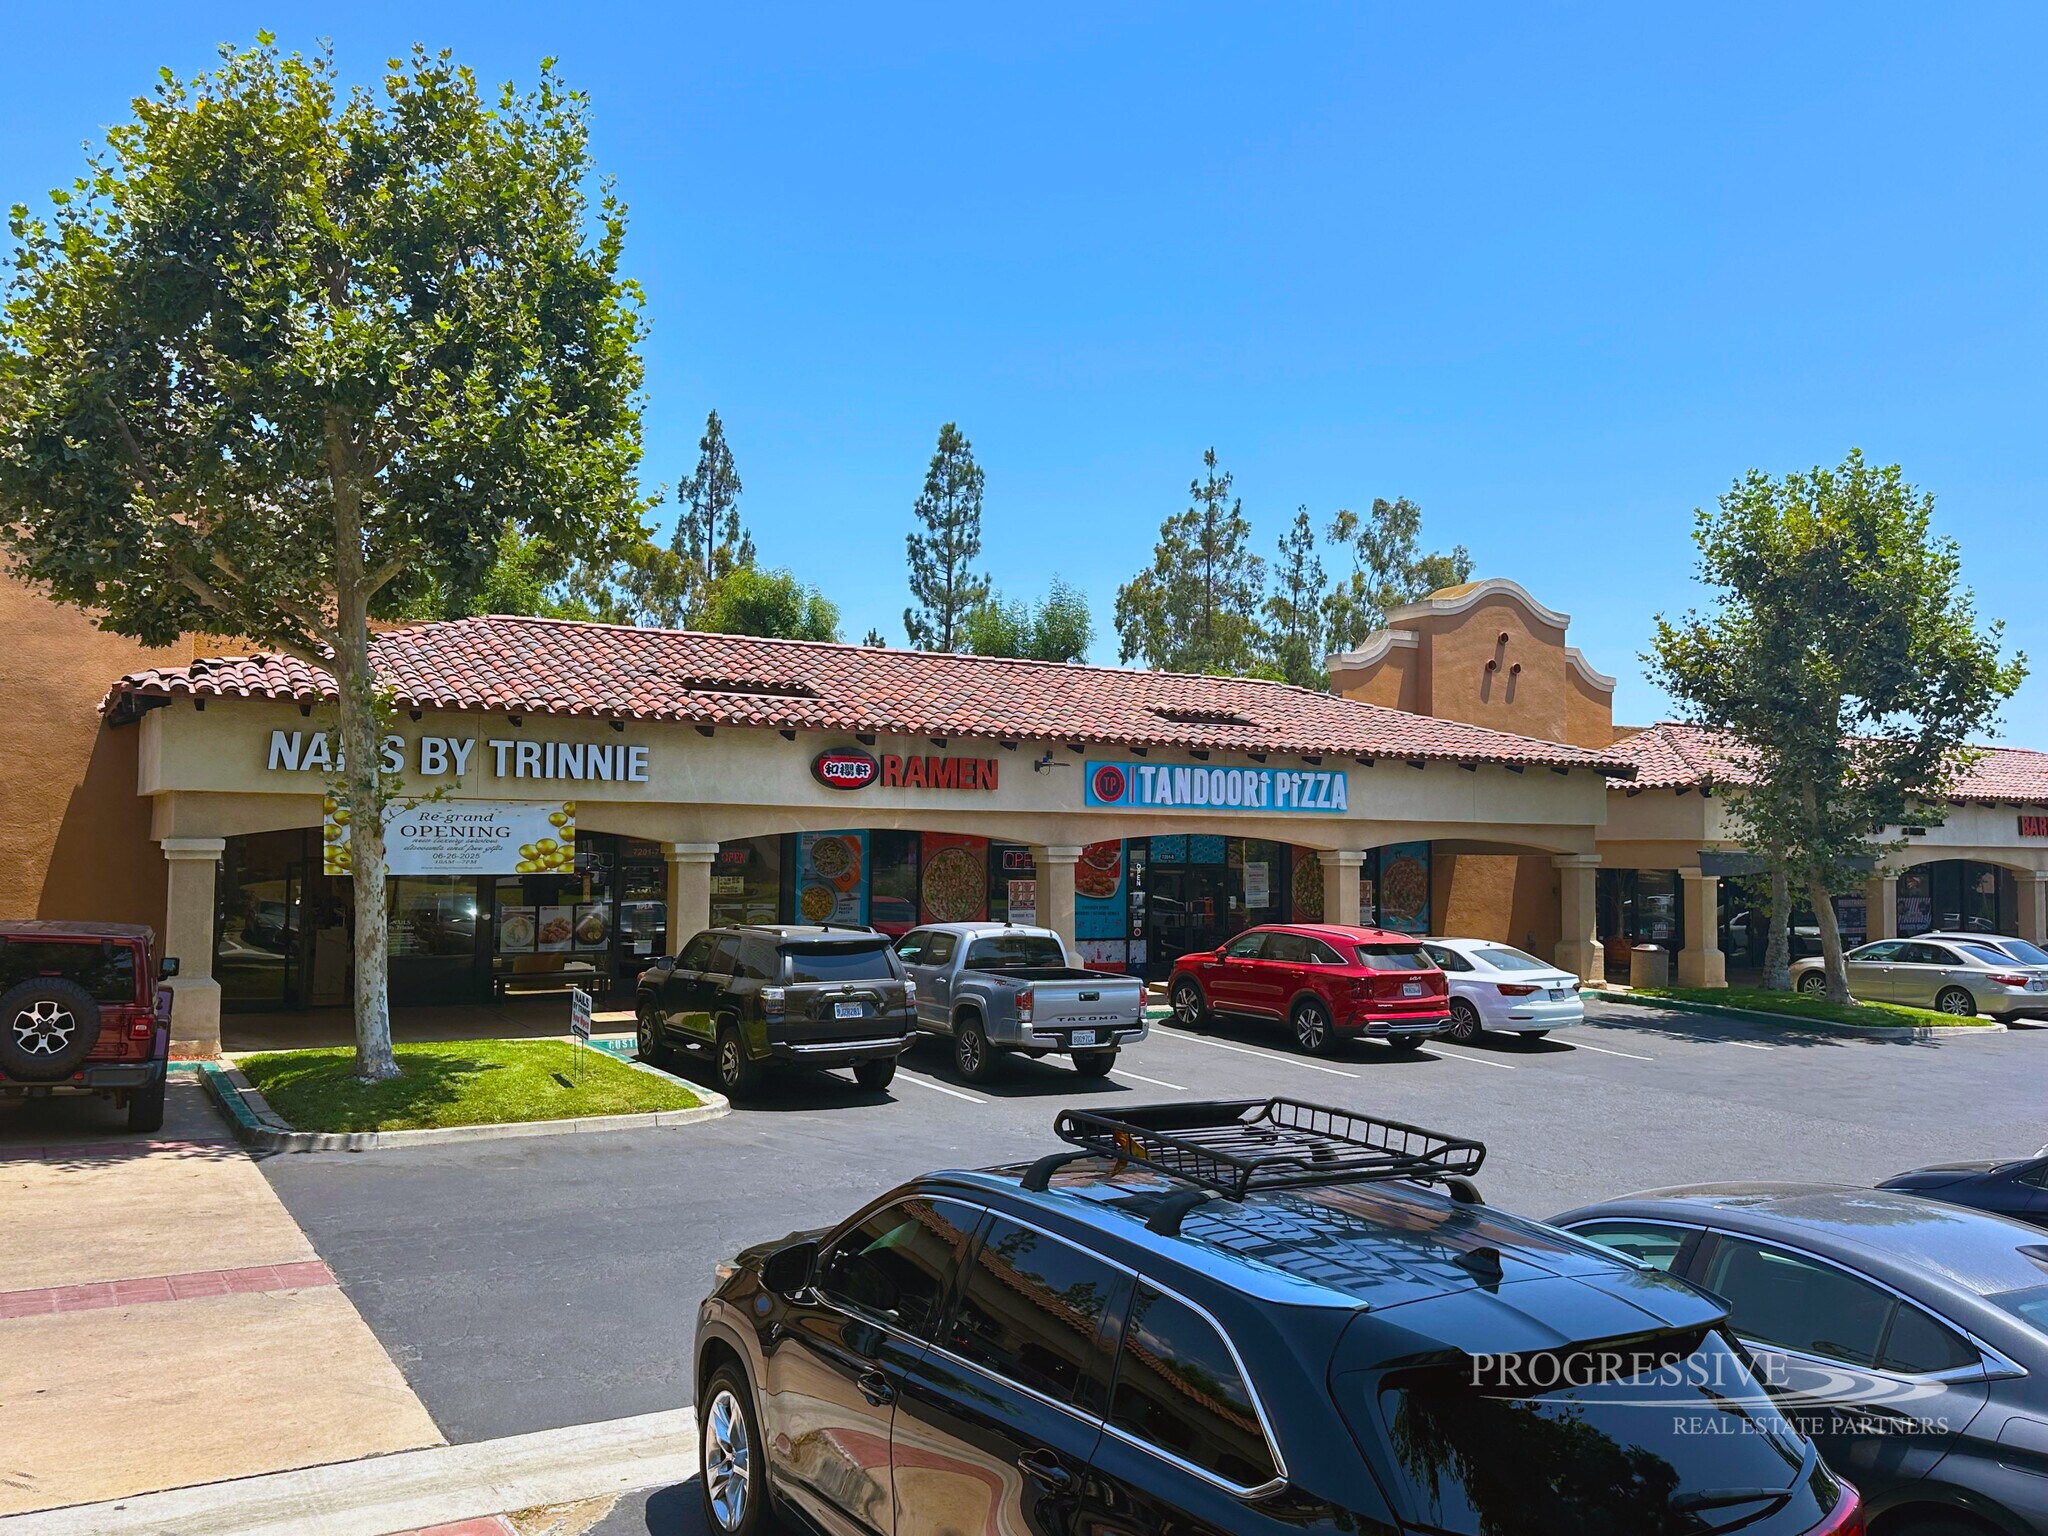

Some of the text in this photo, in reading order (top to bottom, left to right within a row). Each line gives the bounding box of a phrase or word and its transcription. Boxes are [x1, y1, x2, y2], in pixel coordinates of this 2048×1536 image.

[267, 730, 650, 782] NAIS BY TRINNIE
[881, 754, 999, 790] RAMEN
[1103, 776, 1117, 793] TP
[418, 811, 494, 824] Re-grand
[400, 825, 511, 838] OPENING
[1005, 852, 1035, 868] OPE
[574, 990, 589, 1009] NAILS
